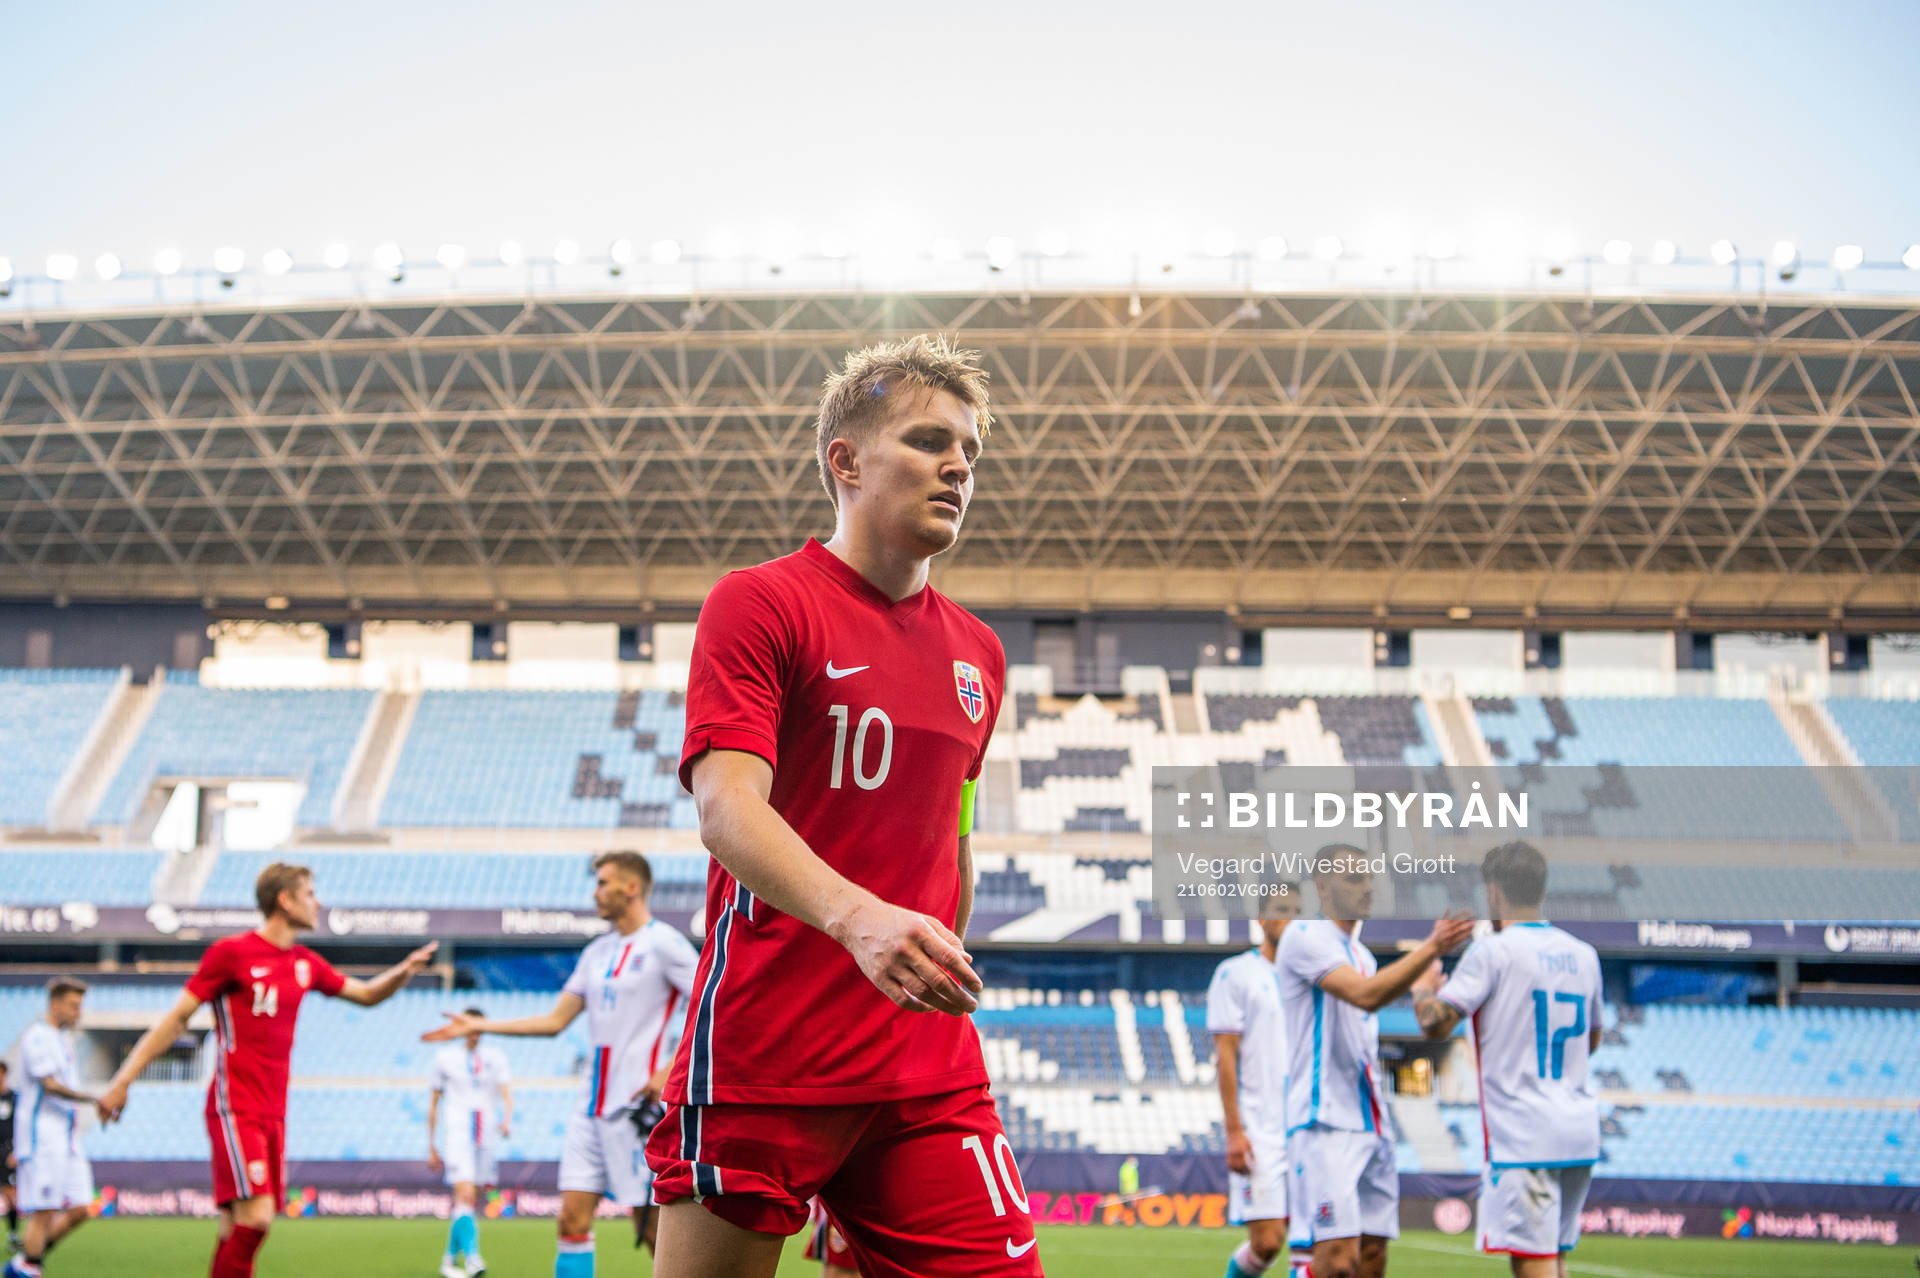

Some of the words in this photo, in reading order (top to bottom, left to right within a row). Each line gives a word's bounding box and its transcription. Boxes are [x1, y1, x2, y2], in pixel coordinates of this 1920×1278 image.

[828, 705, 893, 790] 10
[252, 981, 278, 1017] 14
[1532, 989, 1586, 1080] 17
[962, 1133, 1030, 1216] 10
[1755, 1210, 1817, 1238] Norsk
[1818, 1212, 1898, 1245] Tipping
